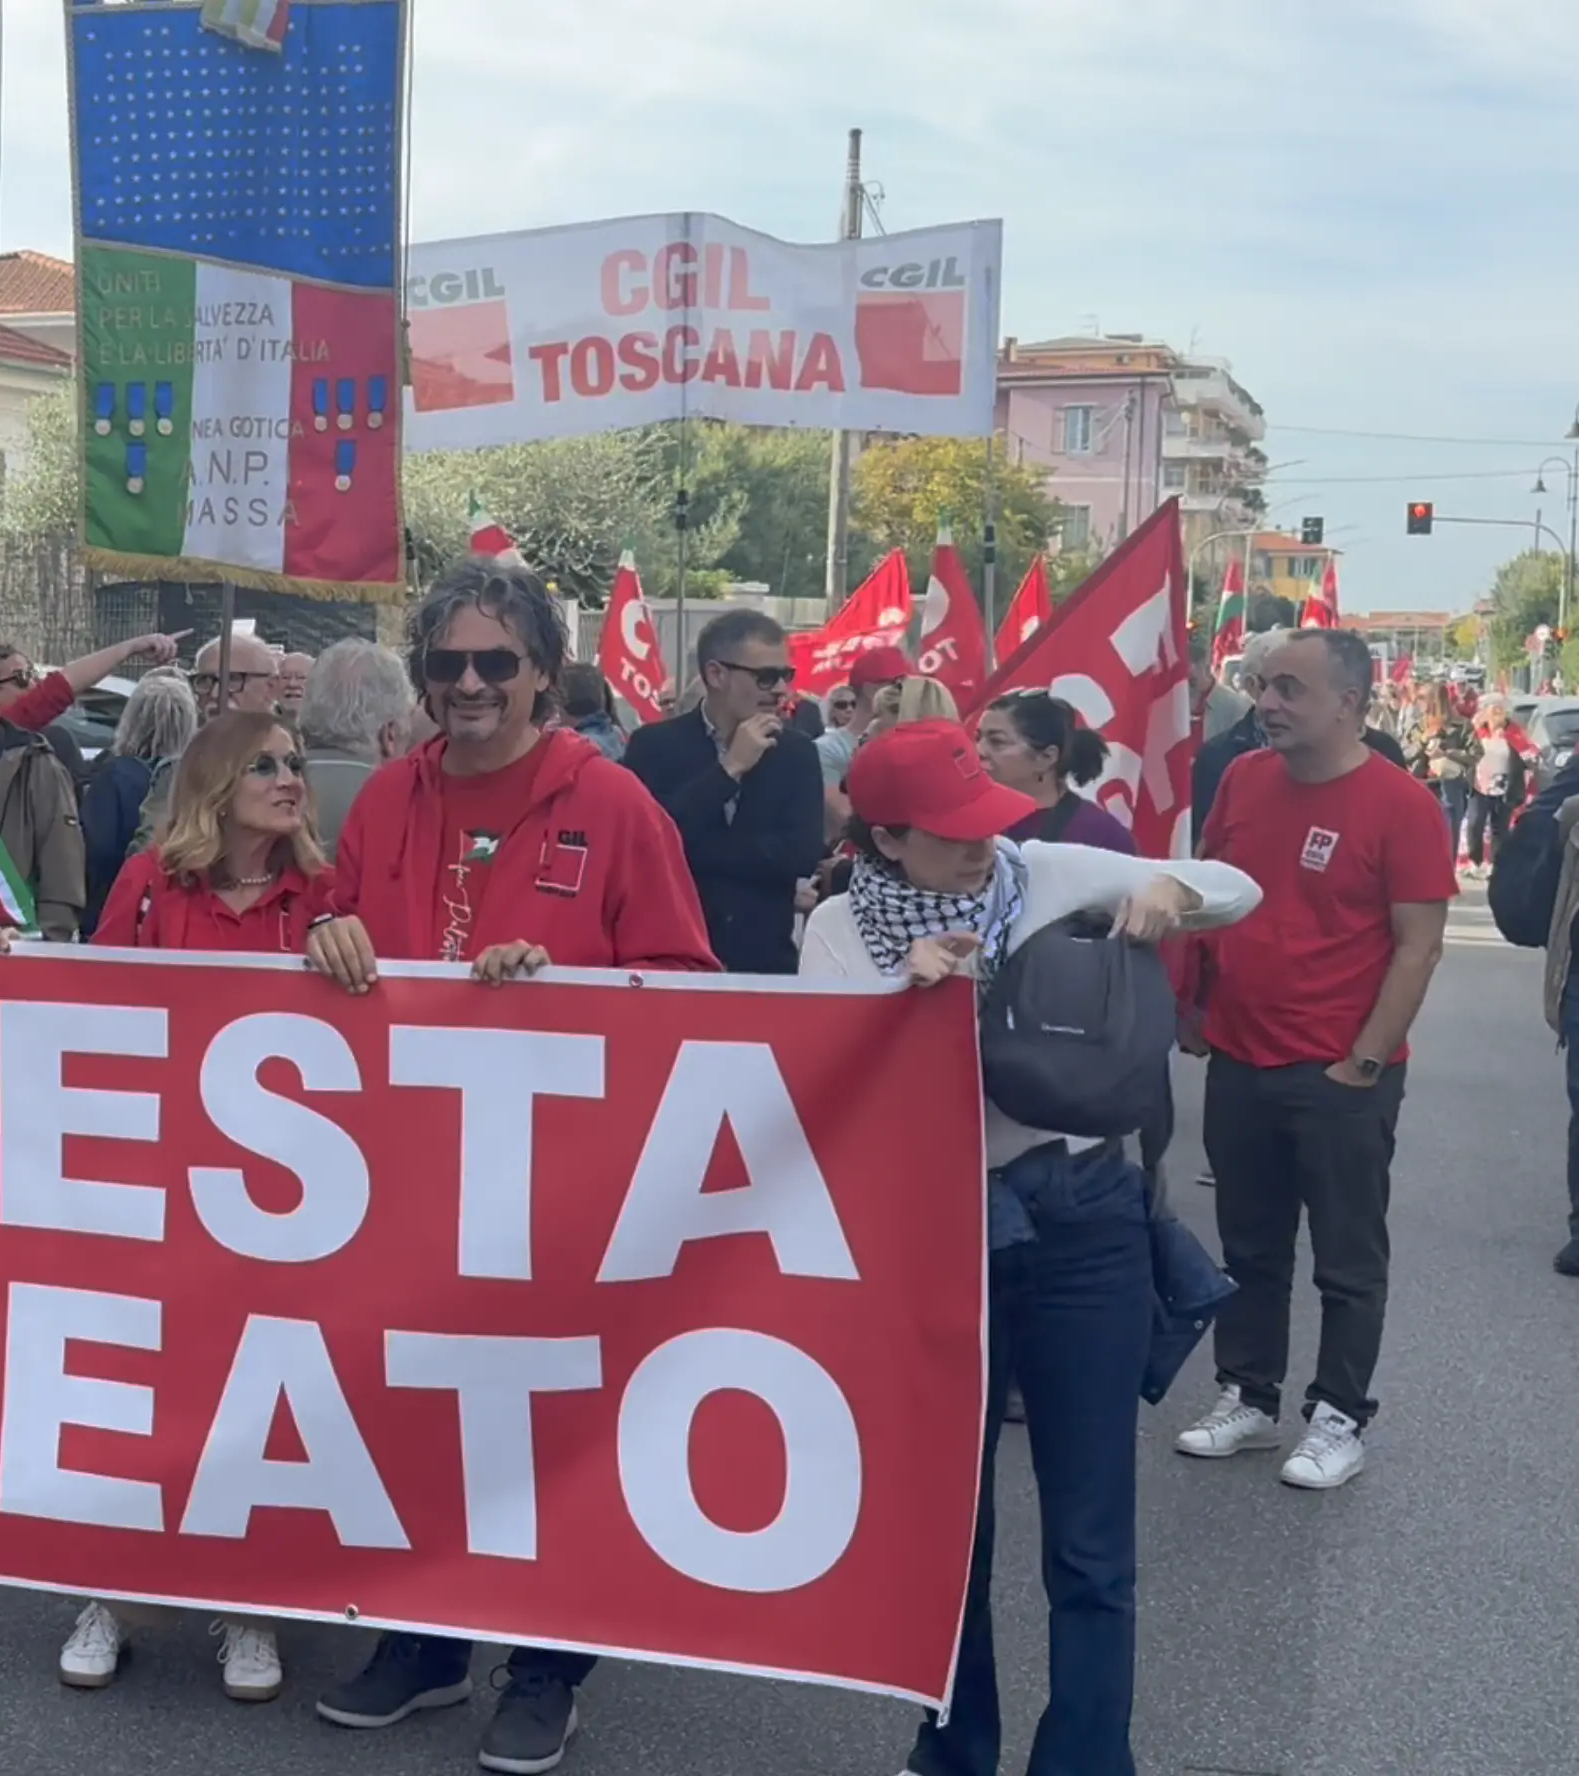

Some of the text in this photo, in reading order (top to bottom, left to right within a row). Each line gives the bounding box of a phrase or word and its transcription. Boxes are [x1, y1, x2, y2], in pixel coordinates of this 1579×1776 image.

[407, 267, 506, 306] CGIL
[600, 242, 770, 317] CGIL
[860, 256, 966, 288] CGIL
[99, 306, 142, 329] PER
[528, 325, 846, 402] TOSCANA
[230, 416, 305, 440] GOTICA
